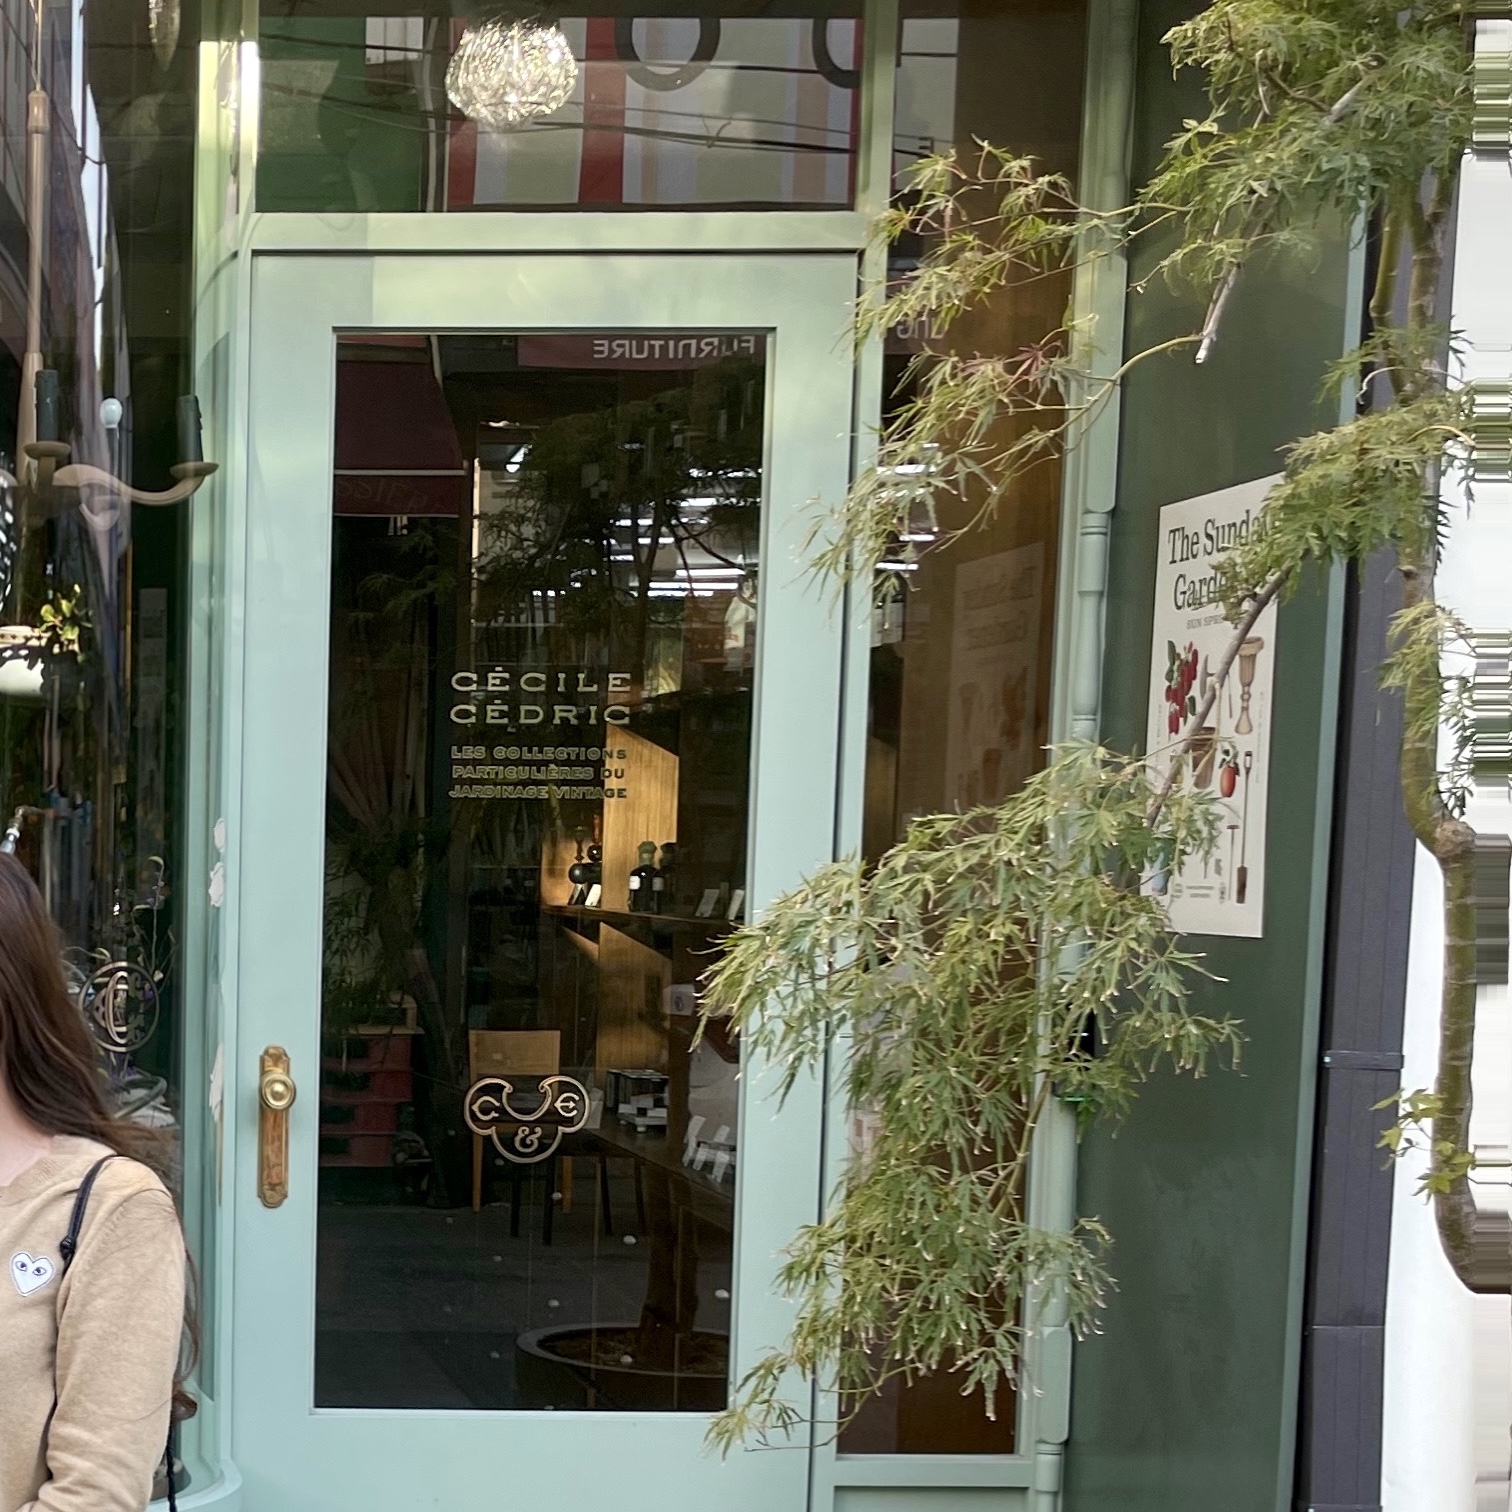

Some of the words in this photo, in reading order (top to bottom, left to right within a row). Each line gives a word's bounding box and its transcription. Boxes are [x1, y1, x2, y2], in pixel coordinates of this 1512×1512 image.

[1168, 526, 1200, 565] The
[450, 746, 486, 760] LES
[493, 747, 627, 760] COLLECTIONS
[601, 769, 625, 779] DU
[448, 785, 549, 799] JARDINAGE
[550, 786, 627, 799] VINTAGE
